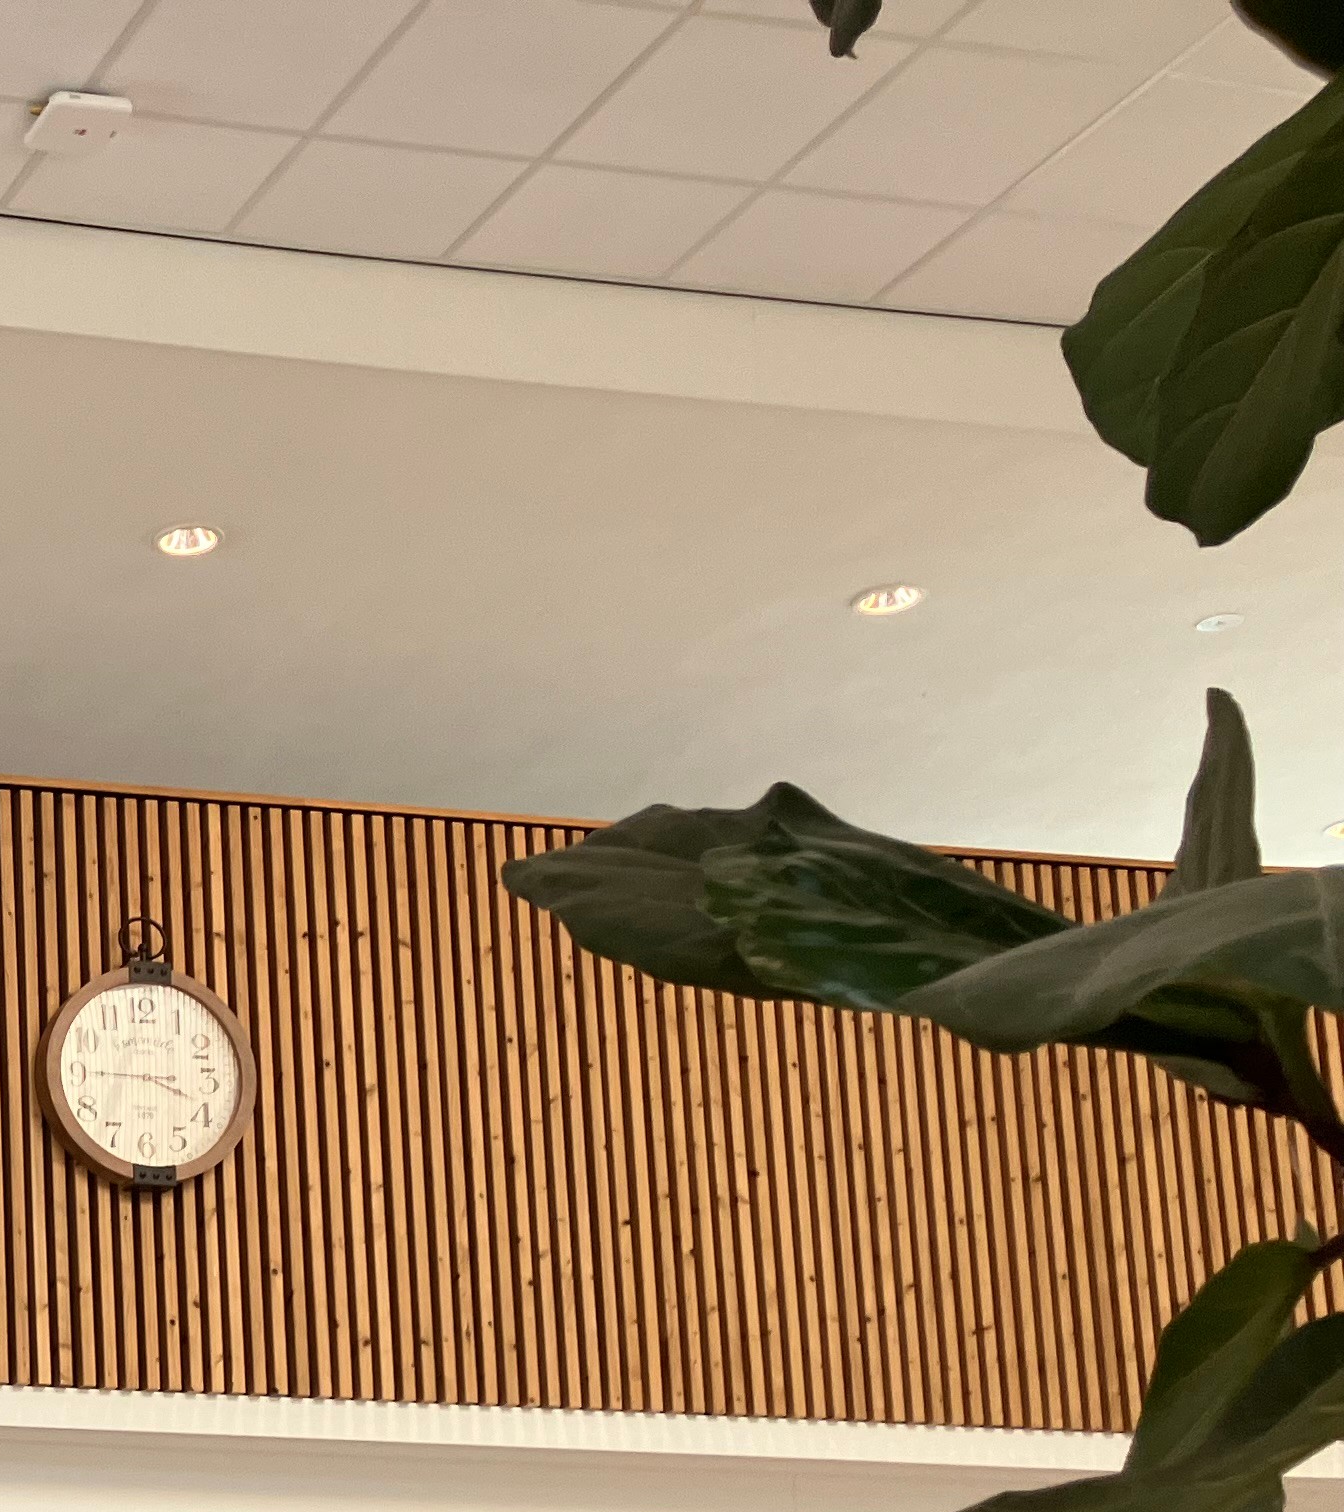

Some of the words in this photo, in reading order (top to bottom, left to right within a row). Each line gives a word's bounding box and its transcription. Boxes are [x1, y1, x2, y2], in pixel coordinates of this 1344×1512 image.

[100, 1004, 119, 1031] 11
[130, 996, 157, 1024] 12
[171, 1009, 183, 1036] 1
[75, 1025, 100, 1053] 10
[191, 1033, 210, 1060] 2
[69, 1061, 88, 1087] 9
[198, 1067, 220, 1095] 3
[76, 1095, 98, 1122] 8
[190, 1102, 214, 1128] 4
[105, 1121, 122, 1149] 7
[137, 1131, 157, 1159] 6
[169, 1126, 187, 1152] 5
